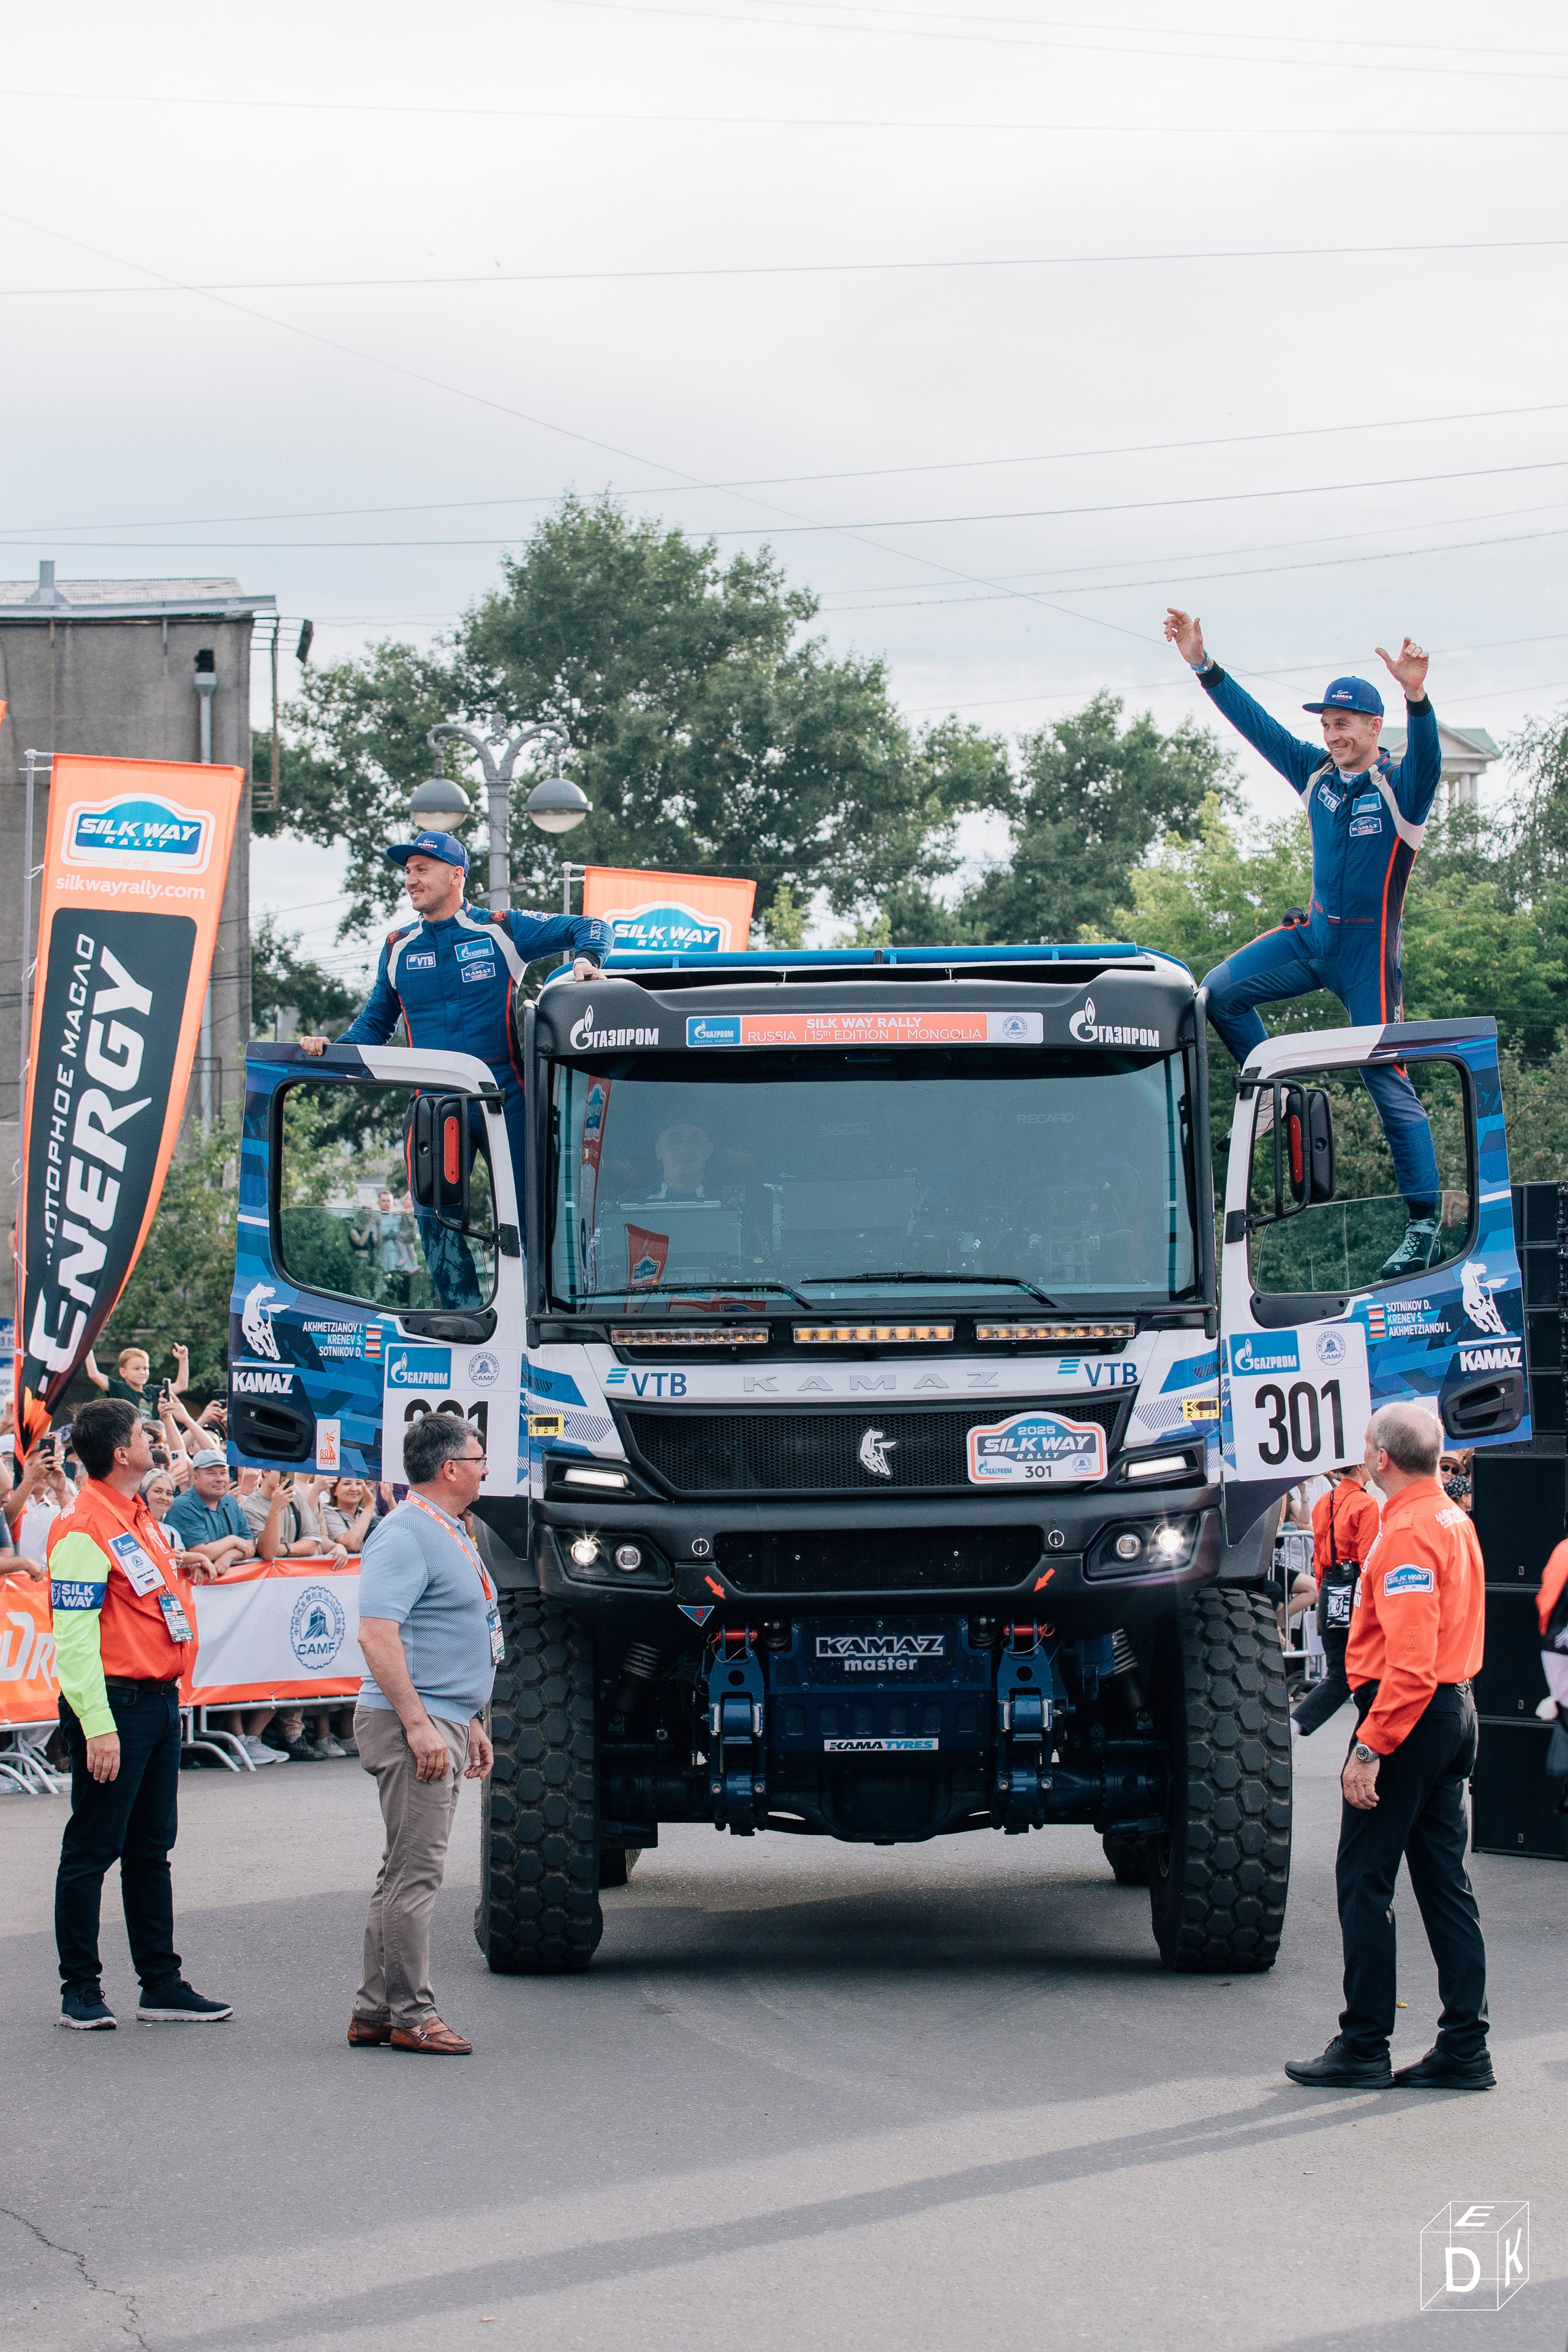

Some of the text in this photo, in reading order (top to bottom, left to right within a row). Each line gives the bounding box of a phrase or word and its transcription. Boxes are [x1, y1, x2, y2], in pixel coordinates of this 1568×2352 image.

[78, 818, 201, 842] SILK WAY
[104, 837, 168, 848] RALLY
[56, 875, 205, 900] silkwayrally.com
[614, 924, 668, 940] SILK
[669, 925, 718, 944] WAY
[638, 940, 692, 949] RALLY
[417, 956, 434, 967] VTB
[465, 968, 492, 977] KAMAZ
[61, 933, 95, 1058] МАСЛО
[807, 1017, 922, 1028] SILK WAY RALLY
[593, 1028, 659, 1048] ГАЗПРОМ
[748, 1028, 982, 1042] RUSSIA 15th EDITION MONGOLIA
[1098, 1025, 1160, 1048] ГАЗПРОМ
[1017, 1112, 1074, 1124] RECARO
[1385, 1299, 1431, 1313] SOTNIKOV D.
[1387, 1312, 1424, 1325] KRENEV S.
[303, 1321, 360, 1333] AKHMETZIANOV
[1388, 1322, 1451, 1337] AKHMETZIANOV I.
[327, 1334, 363, 1345] KRENEV S.
[318, 1346, 363, 1357] SOTNIKOV D.
[1459, 1346, 1523, 1371] KAMAZ
[1254, 1354, 1297, 1370] GAZPROM
[407, 1372, 448, 1384] GAZPROM
[744, 1371, 999, 1392] KAMAZ
[1084, 1362, 1138, 1387] VTB
[232, 1372, 293, 1394] KAMAZ
[631, 1372, 687, 1397] VTB
[1254, 1379, 1345, 1465] 301
[1017, 1425, 1055, 1435] 2025
[982, 1436, 1091, 1453] SILK WAY
[320, 1449, 329, 1458] 80
[1025, 1465, 1052, 1479] 301
[1387, 1574, 1407, 1585] SILK
[61, 1583, 95, 1596] SILK
[62, 1596, 95, 1607] WAY
[298, 1643, 335, 1655] CAMF
[816, 1635, 944, 1657] KAMAZ
[844, 1657, 918, 1671] master
